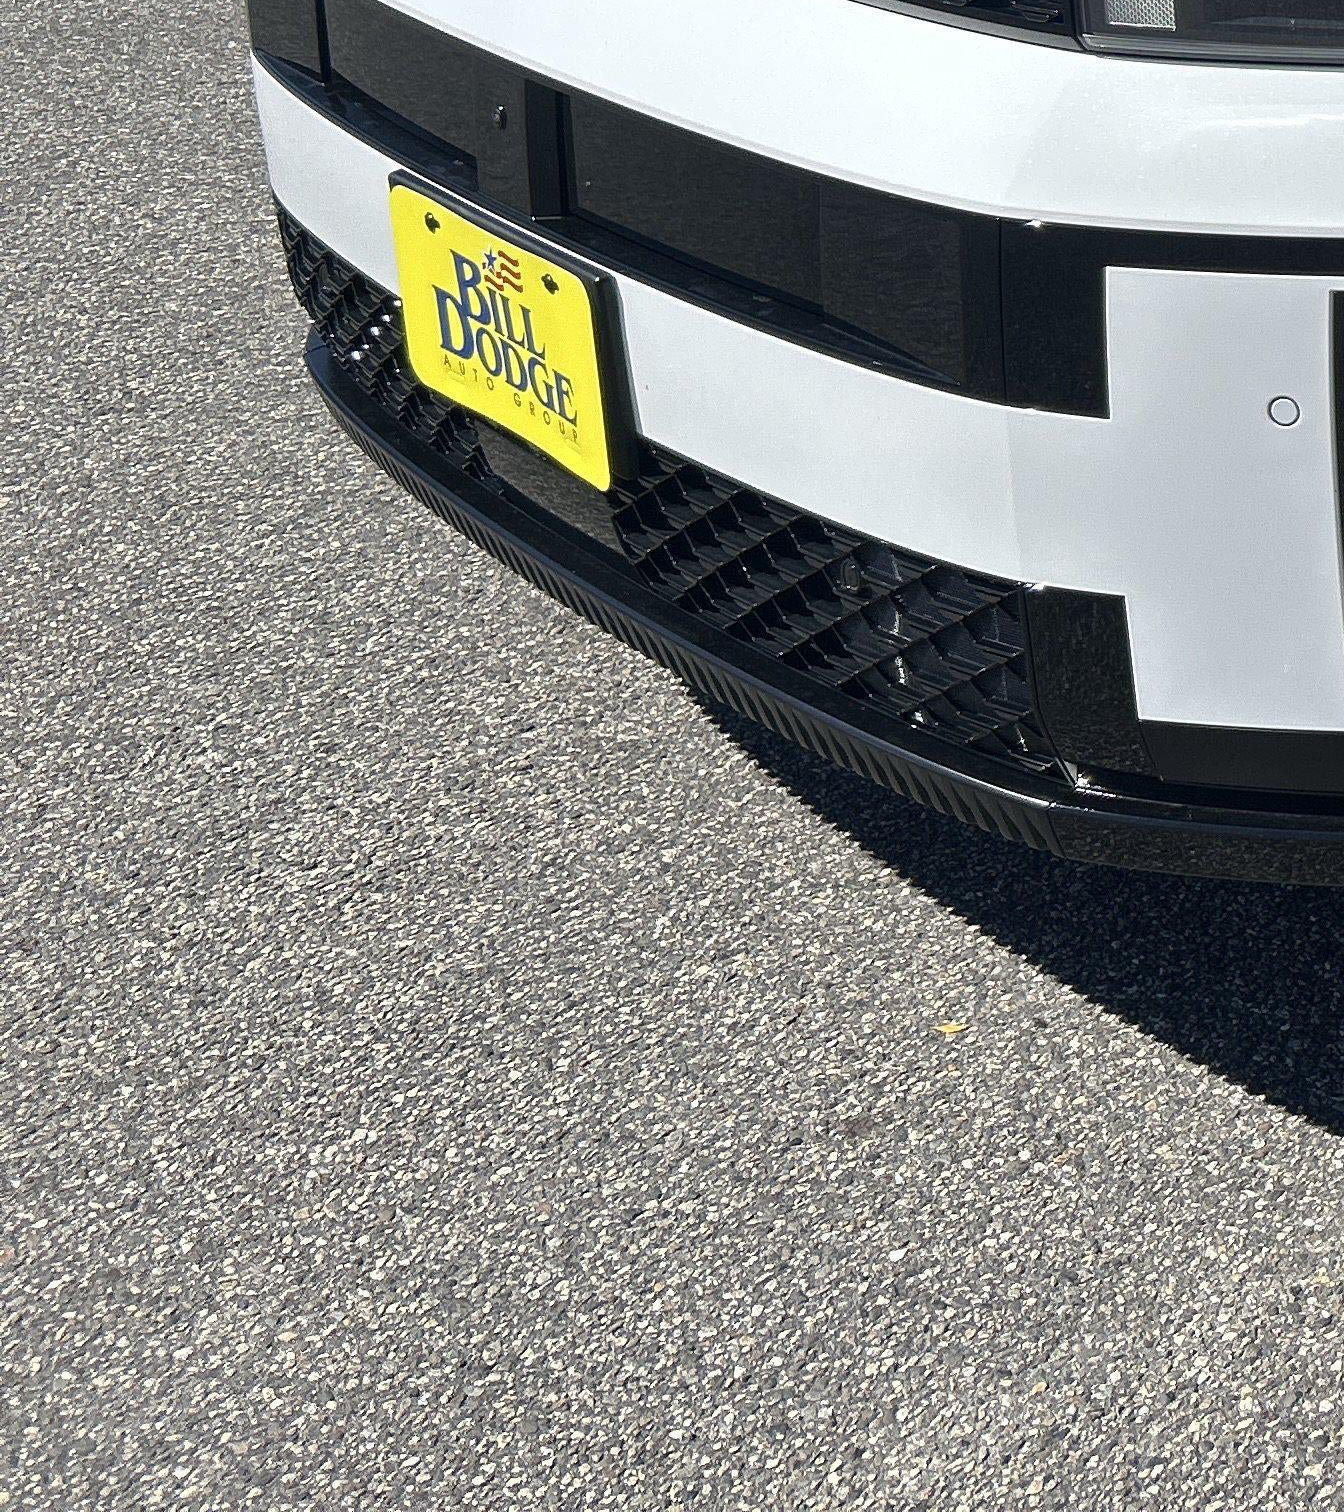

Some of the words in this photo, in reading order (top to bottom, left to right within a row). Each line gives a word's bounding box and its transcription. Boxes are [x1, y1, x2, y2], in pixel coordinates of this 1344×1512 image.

[432, 284, 577, 427] DODGE
[449, 249, 545, 360] BILL
[443, 354, 494, 391] AUTO
[513, 393, 578, 440] GROUP
